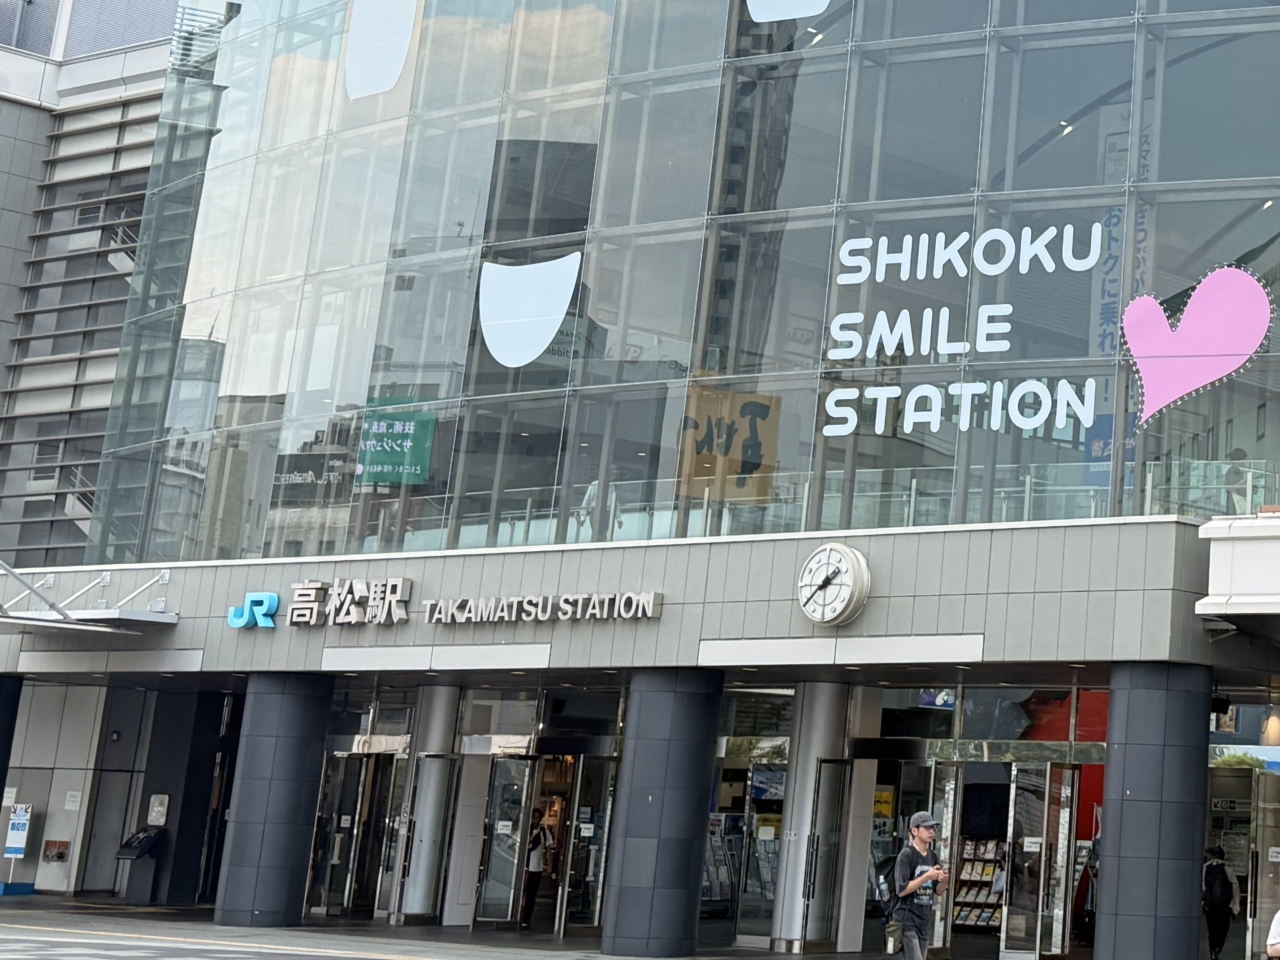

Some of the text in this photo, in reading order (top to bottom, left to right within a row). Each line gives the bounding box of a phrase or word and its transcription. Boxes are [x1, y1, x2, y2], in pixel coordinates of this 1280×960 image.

[836, 222, 1102, 285] SHIKOKU
[827, 303, 1013, 360] SMILE
[822, 378, 1096, 437] STATION
[227, 592, 279, 628] JR
[286, 577, 411, 627] 高松駅
[422, 591, 663, 625] TAKAMATSU STATION
